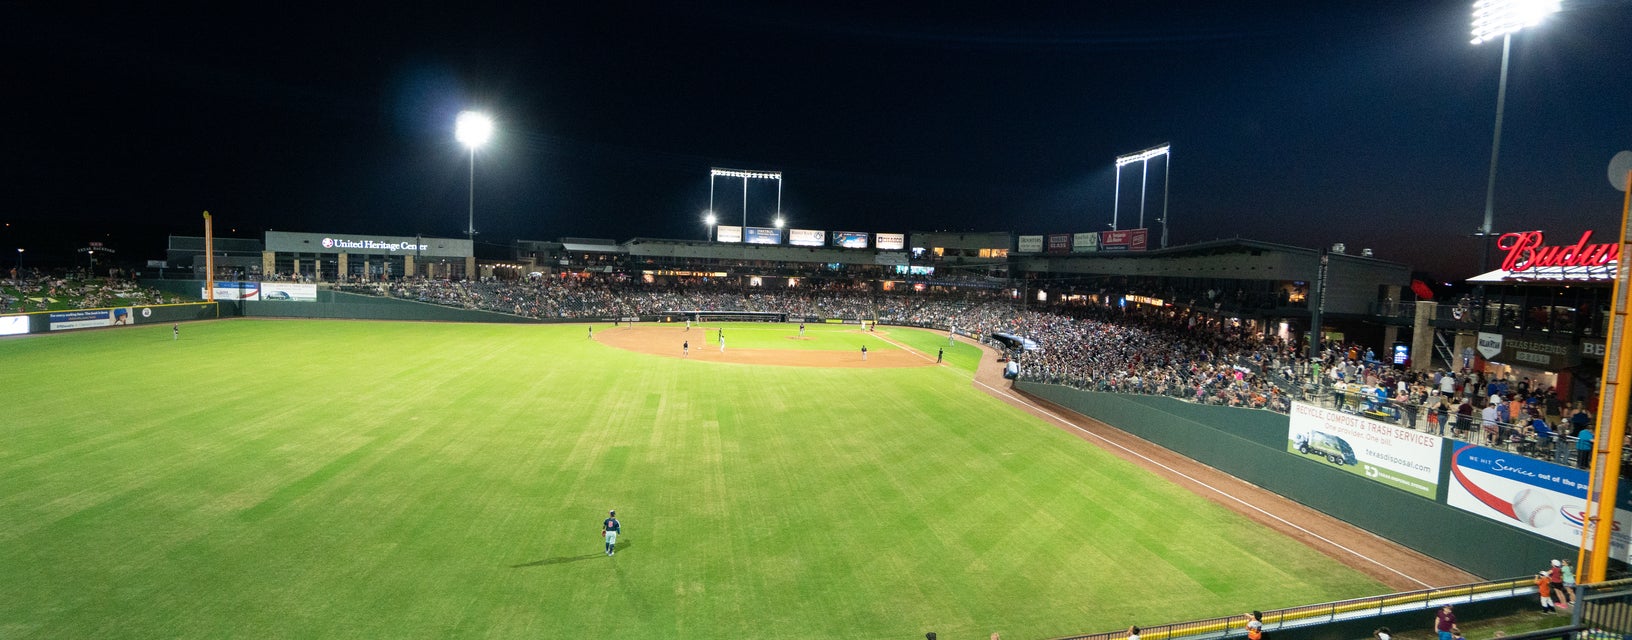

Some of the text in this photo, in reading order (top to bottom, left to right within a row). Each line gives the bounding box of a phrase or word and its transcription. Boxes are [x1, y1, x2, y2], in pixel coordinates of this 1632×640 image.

[333, 239, 428, 251] United Heritage Cener
[1497, 230, 1620, 271] Budw
[1505, 339, 1567, 356] TEXAS LEGENDS
[1583, 342, 1605, 355] BE
[1325, 423, 1336, 432] One
[1366, 433, 1379, 443] One
[1326, 412, 1358, 428] COMPOST
[1360, 420, 1365, 430] &
[1368, 422, 1392, 437] TRASH
[1394, 429, 1434, 448] SERVICES
[1366, 449, 1431, 473] texasdisposal.com
[1492, 458, 1536, 477] Service
[1538, 473, 1550, 481] out
[1562, 478, 1575, 487] the
[1577, 482, 1588, 490] pa
